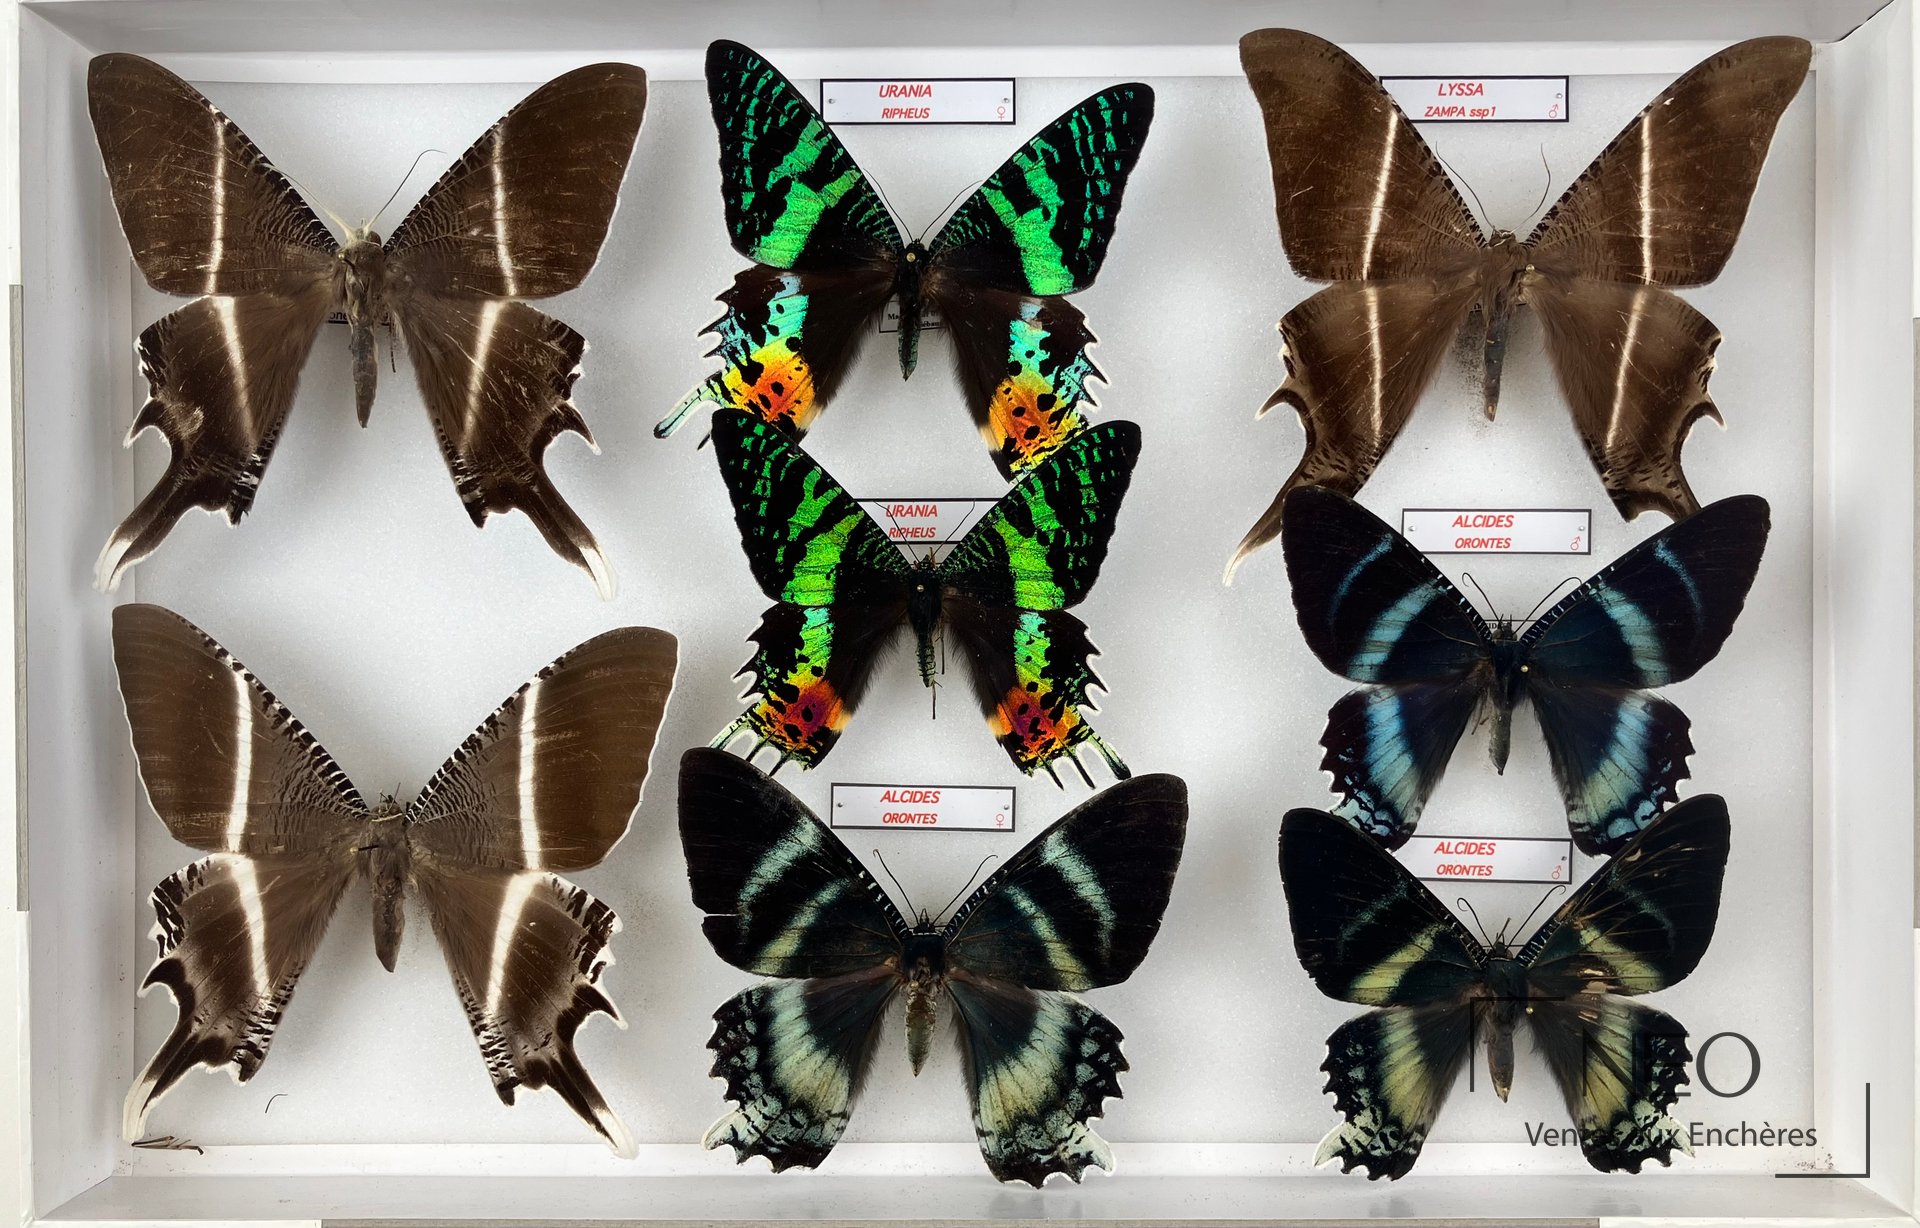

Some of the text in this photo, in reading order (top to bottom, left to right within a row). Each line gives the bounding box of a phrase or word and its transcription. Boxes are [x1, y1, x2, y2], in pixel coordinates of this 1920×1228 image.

[879, 83, 933, 98] URANIA
[1438, 81, 1484, 97] LYSSA
[881, 107, 930, 120] RIPHEUS
[1424, 105, 1466, 118] ZAMPA
[885, 504, 939, 518] URANIA
[1452, 513, 1515, 529] ALCIDES
[888, 526, 936, 539] RIPHEUS
[1455, 536, 1512, 550] ORONTES
[880, 789, 941, 805] ALCIDES
[881, 812, 939, 825] ORONTES
[1434, 841, 1497, 857] ALCIDES
[1436, 863, 1494, 877] ORONTES
